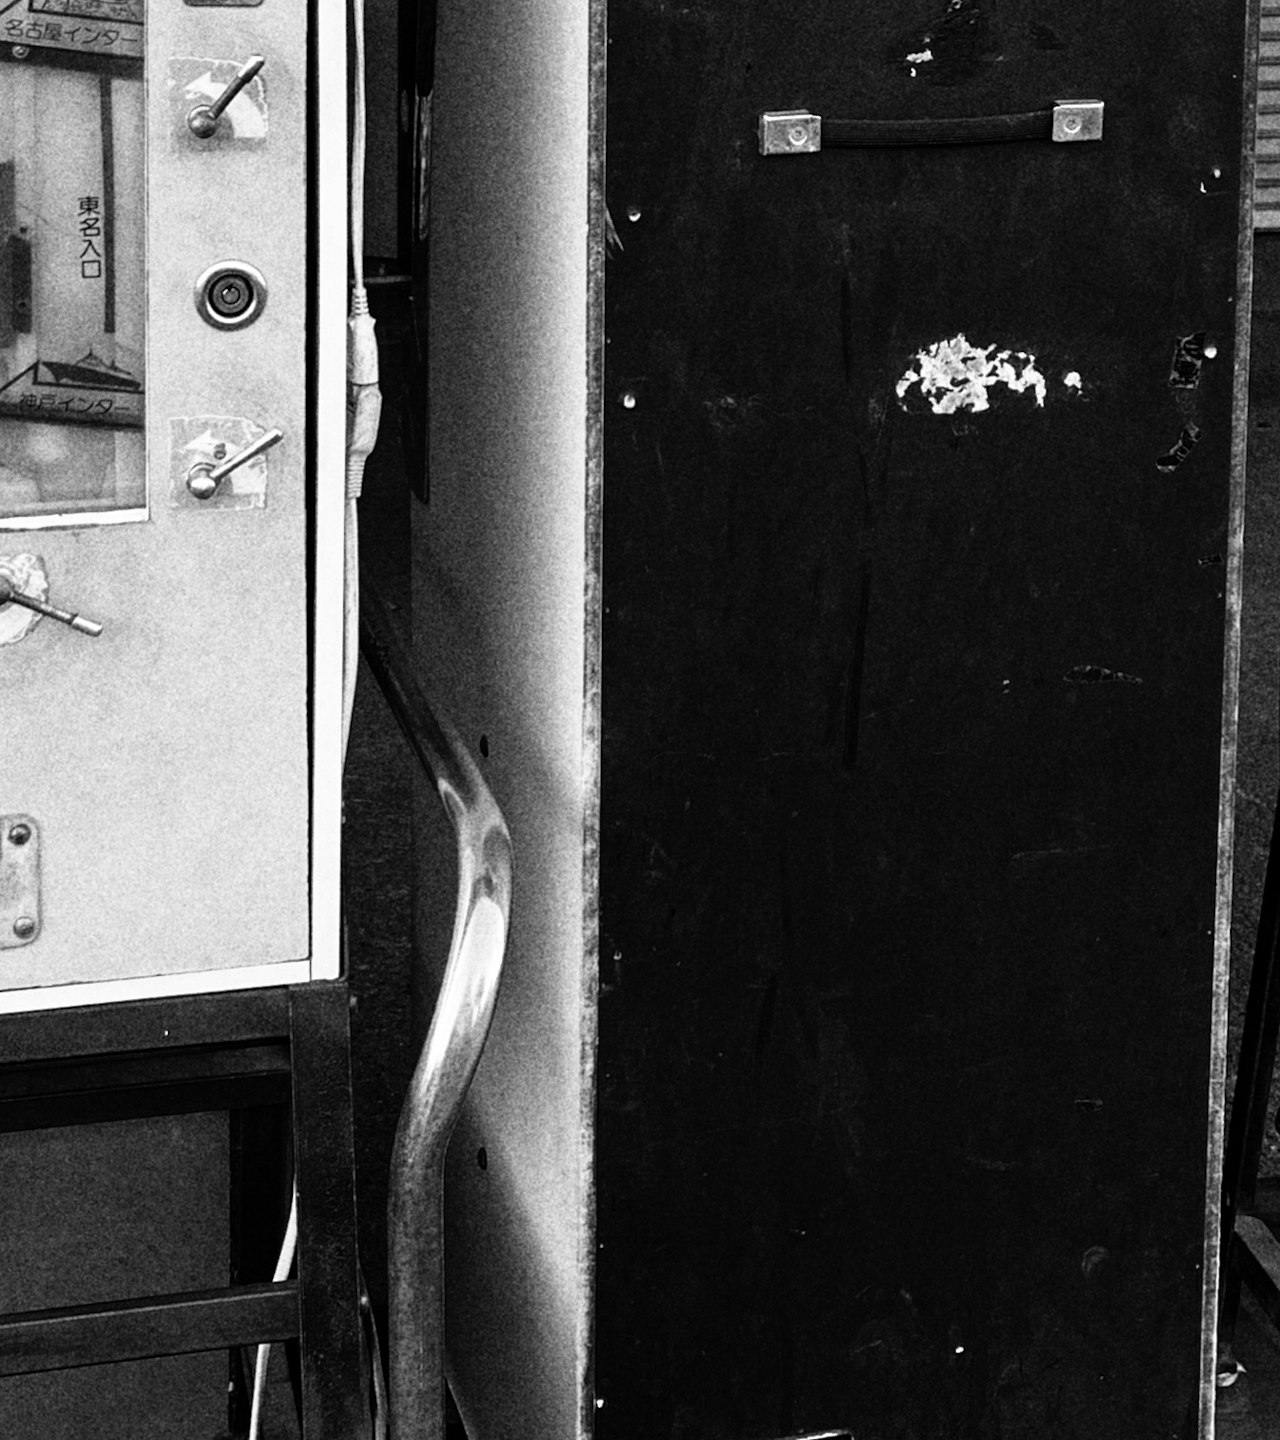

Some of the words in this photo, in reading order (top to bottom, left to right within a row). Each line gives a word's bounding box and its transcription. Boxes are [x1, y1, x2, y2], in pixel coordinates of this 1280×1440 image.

[4, 17, 140, 46] 名古屋インター
[77, 195, 102, 280] 東名入口
[18, 392, 131, 417] 神戸インター
